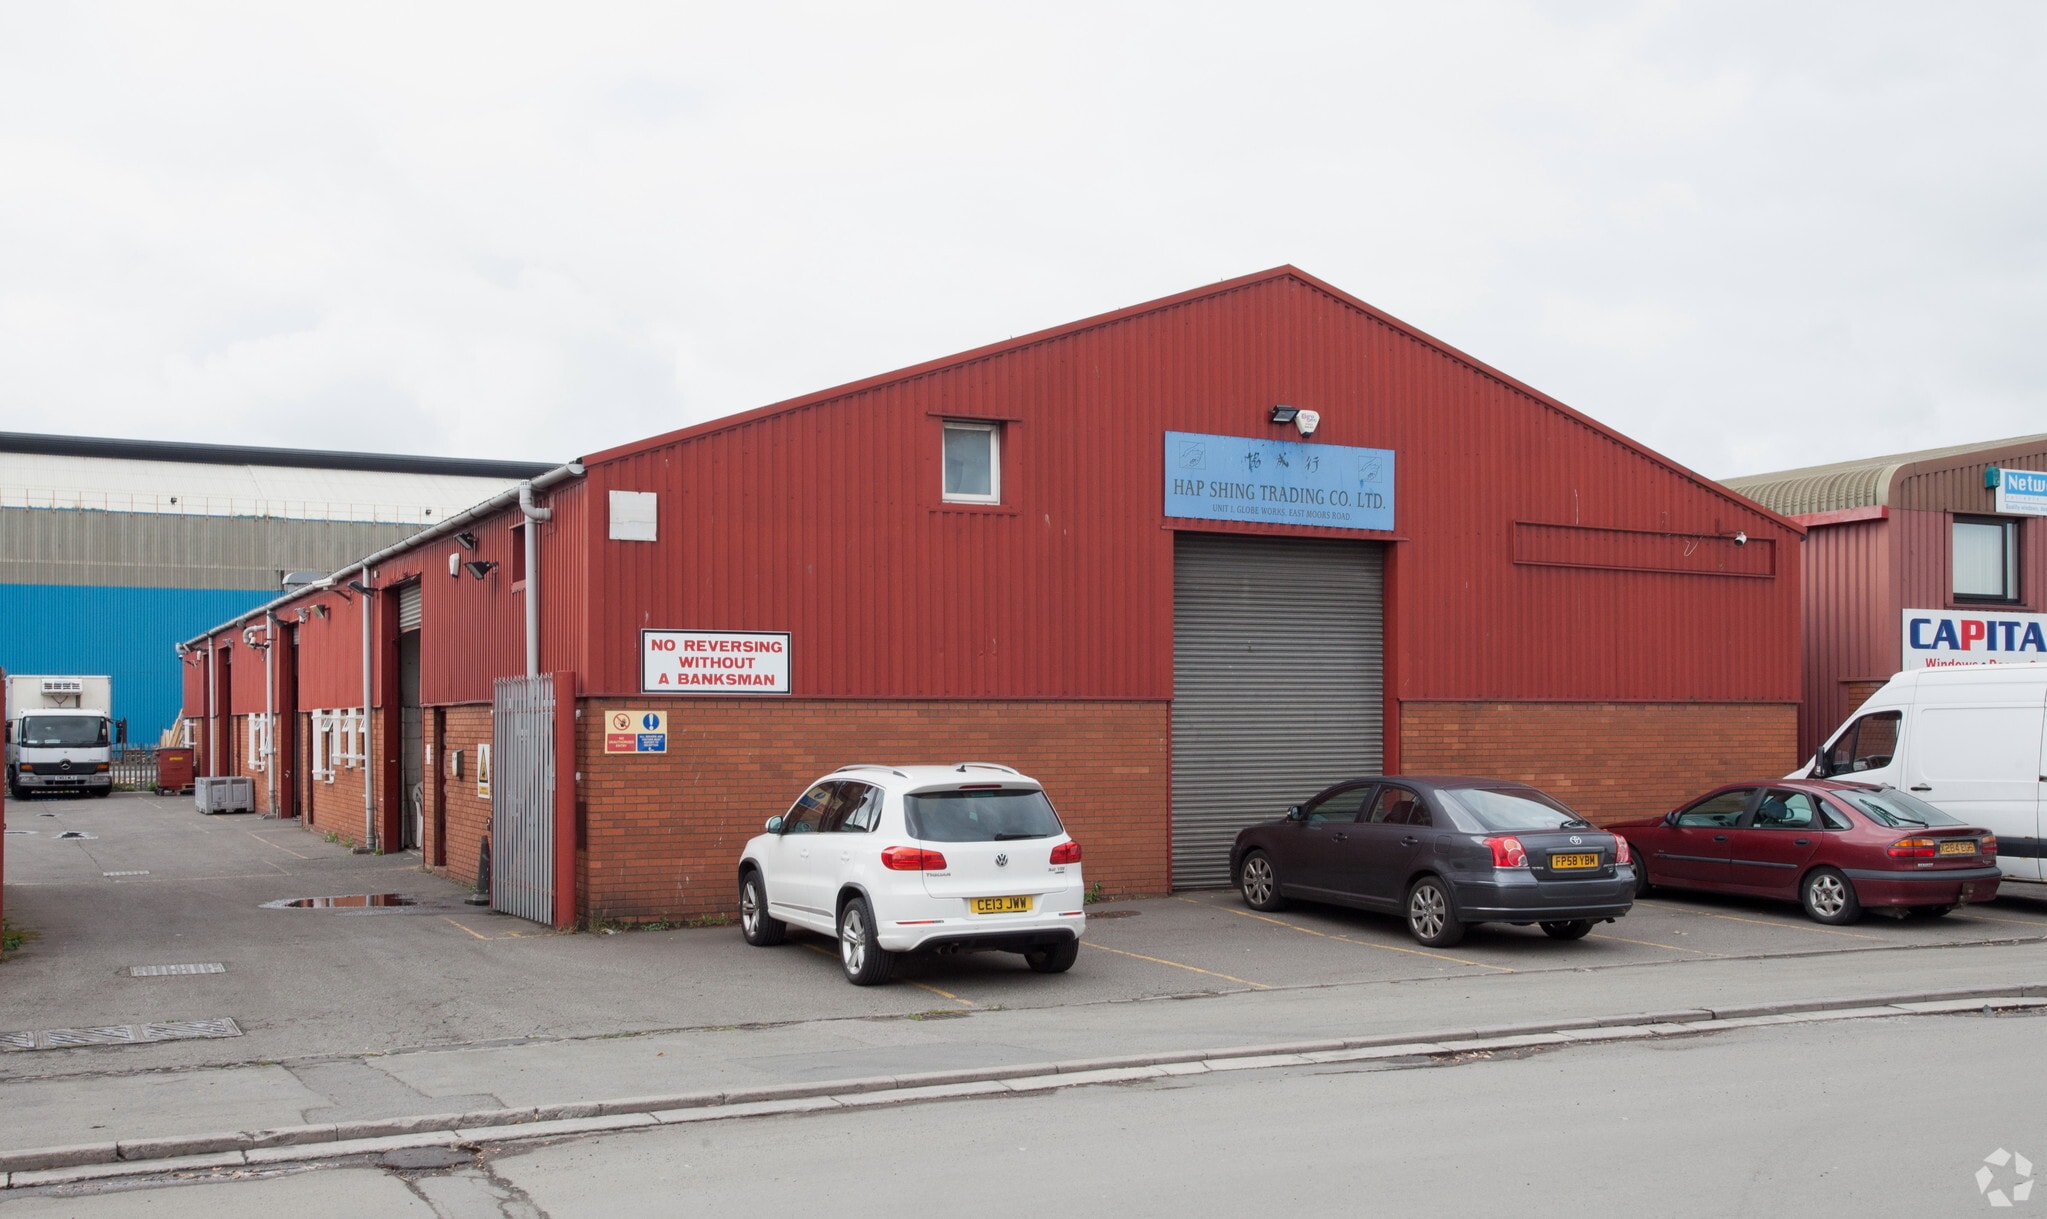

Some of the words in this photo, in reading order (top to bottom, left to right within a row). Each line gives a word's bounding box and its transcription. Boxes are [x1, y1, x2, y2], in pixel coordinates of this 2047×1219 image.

[2008, 474, 2047, 493] Netw
[1173, 478, 1205, 497] HAP
[1209, 481, 1256, 500] SHING
[1260, 485, 1325, 506] TRADING
[1329, 489, 1352, 507] CO.
[1356, 492, 1386, 510] LTD.
[1212, 503, 1229, 513] UNIT
[1236, 505, 1260, 515] GLOBE
[1288, 508, 1305, 517] EAST
[1305, 509, 1331, 520] MOORS
[1909, 618, 2047, 653] CAPITA
[651, 639, 676, 651] NO
[684, 640, 783, 653] REVERSING
[679, 656, 756, 669] WITHOUT
[658, 672, 670, 685] A
[678, 673, 775, 686] BANKSMAN
[1555, 856, 1578, 867] FP58
[977, 898, 1003, 911] CE13
[1006, 896, 1027, 909] JWW
